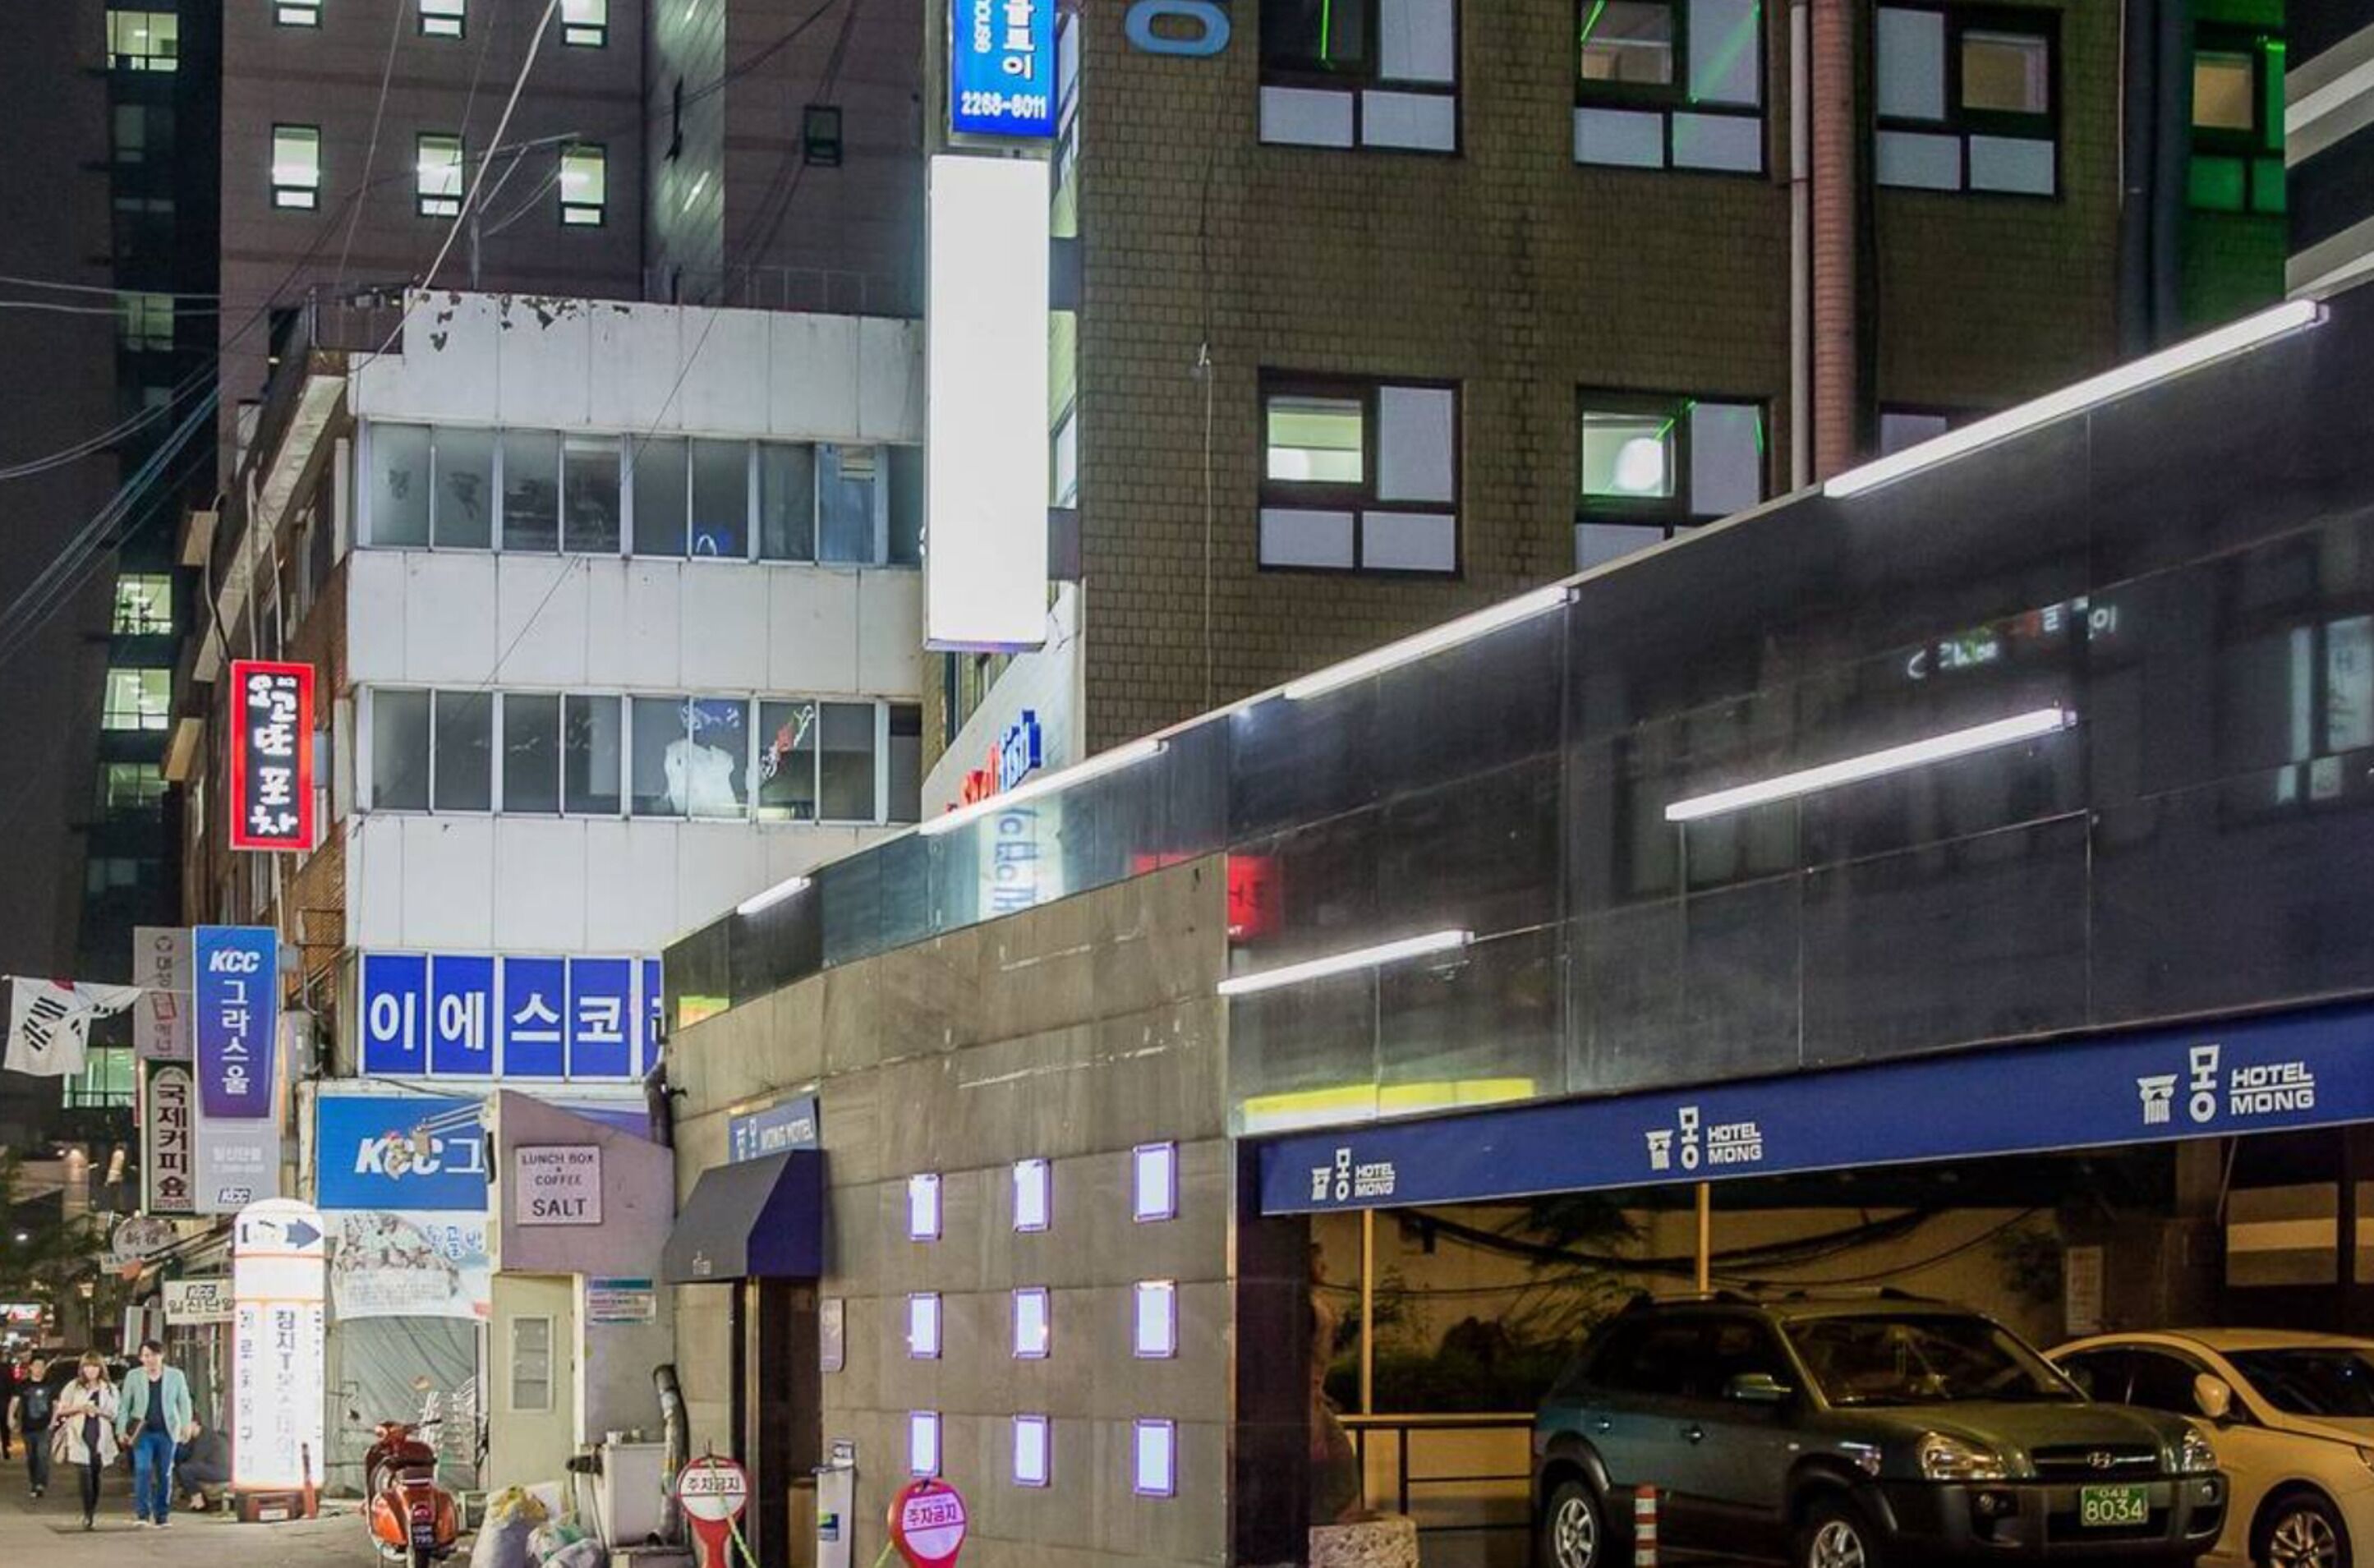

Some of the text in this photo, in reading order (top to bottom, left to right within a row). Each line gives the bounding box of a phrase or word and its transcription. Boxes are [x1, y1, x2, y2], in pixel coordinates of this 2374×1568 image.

[209, 950, 260, 973] KCC
[370, 991, 660, 1051] 이에스코
[220, 980, 251, 1094] 그라스울
[2231, 1062, 2312, 1087] HOTEL
[2231, 1090, 2315, 1115] MONG
[1707, 1122, 1761, 1142] HOTEL
[522, 1154, 564, 1166] LUNCH
[1708, 1145, 1762, 1164] MONG
[1355, 1162, 1395, 1178] HOTEL
[1355, 1181, 1394, 1198] MONG
[532, 1198, 587, 1216] SALT
[907, 1502, 957, 1526] 주차금지
[2086, 1498, 2143, 1520] 8034
